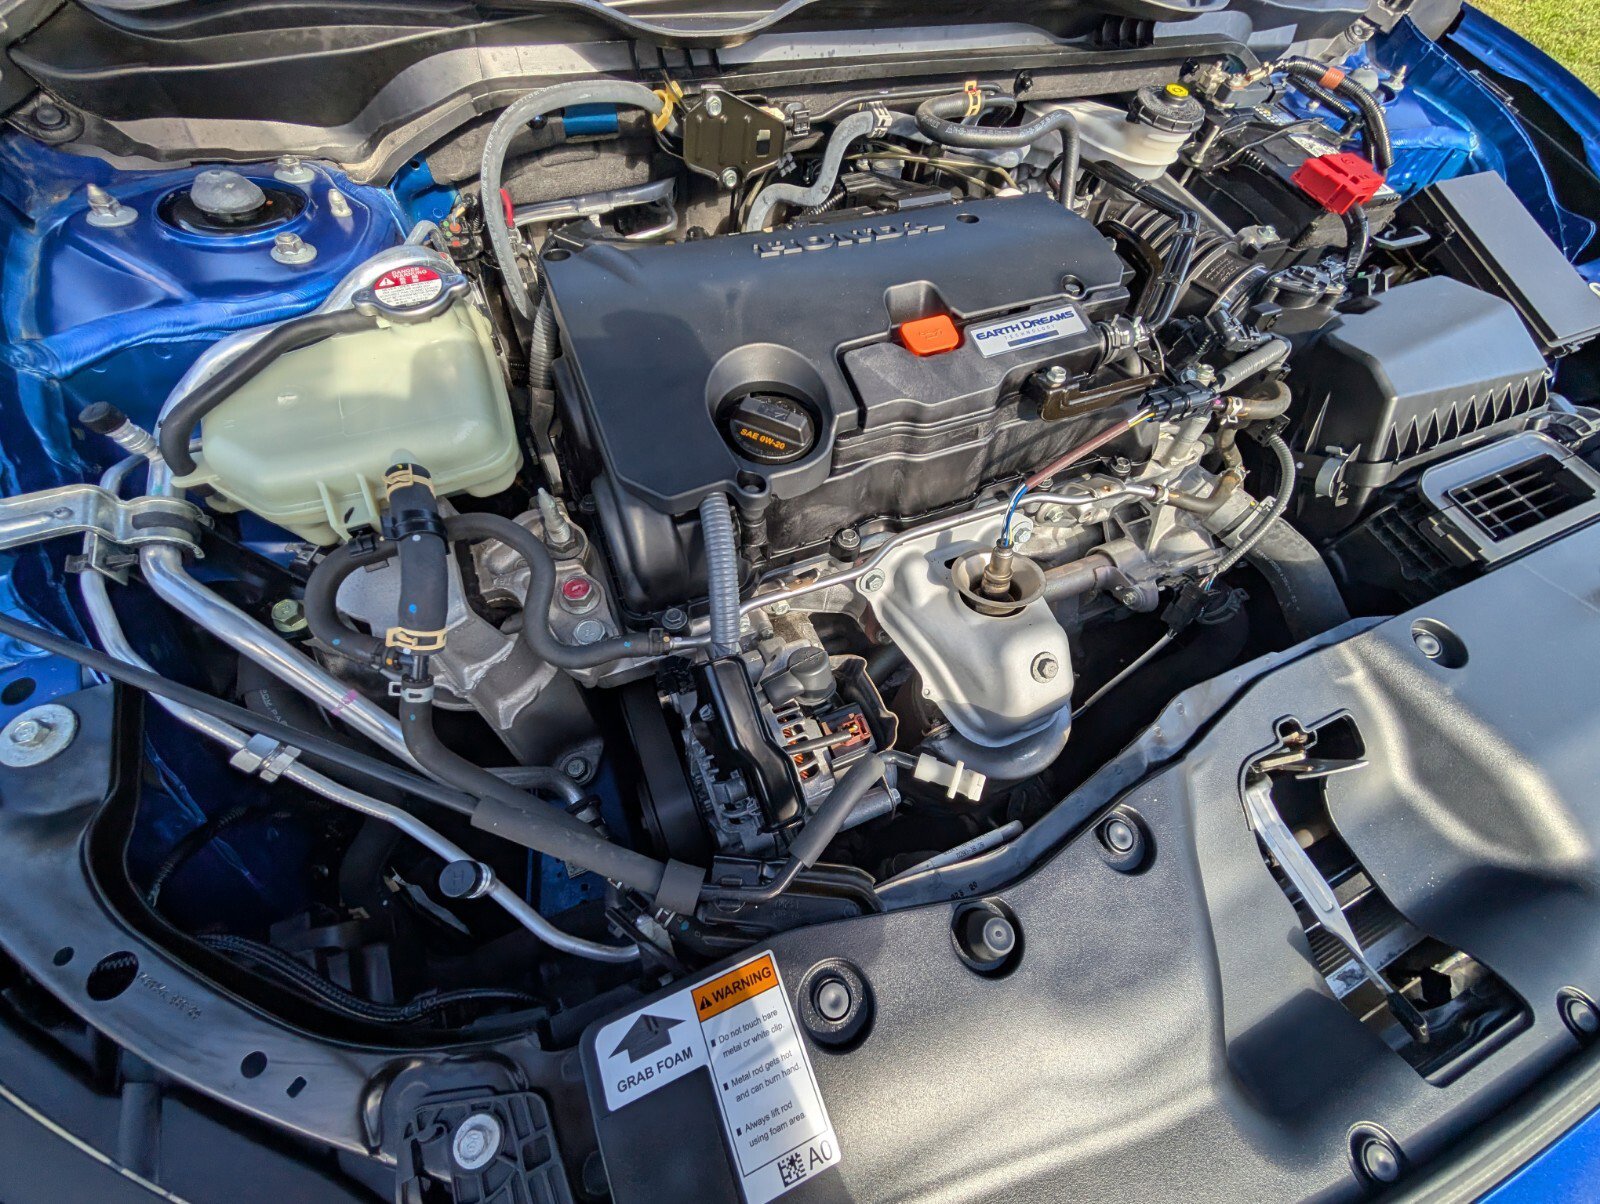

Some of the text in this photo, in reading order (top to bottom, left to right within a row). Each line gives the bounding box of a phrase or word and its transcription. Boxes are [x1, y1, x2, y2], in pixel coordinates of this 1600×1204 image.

[753, 221, 946, 258] HONDA
[976, 310, 1075, 340] EARTH DREAMS
[1005, 324, 1056, 340] TECHNOLOGY
[740, 428, 786, 450] SAE 0W-20
[712, 966, 772, 1003] WARNING
[718, 1009, 778, 1044] Do not touch bare
[722, 1022, 784, 1058] metal or white clip.
[616, 1046, 693, 1093] GRAB FOAM
[731, 1050, 792, 1087] Metal rod gets hot
[736, 1062, 801, 1102] and can burn hand.
[745, 1100, 793, 1133] Always lift rod
[749, 1131, 769, 1147] using
[769, 1121, 788, 1136] foam
